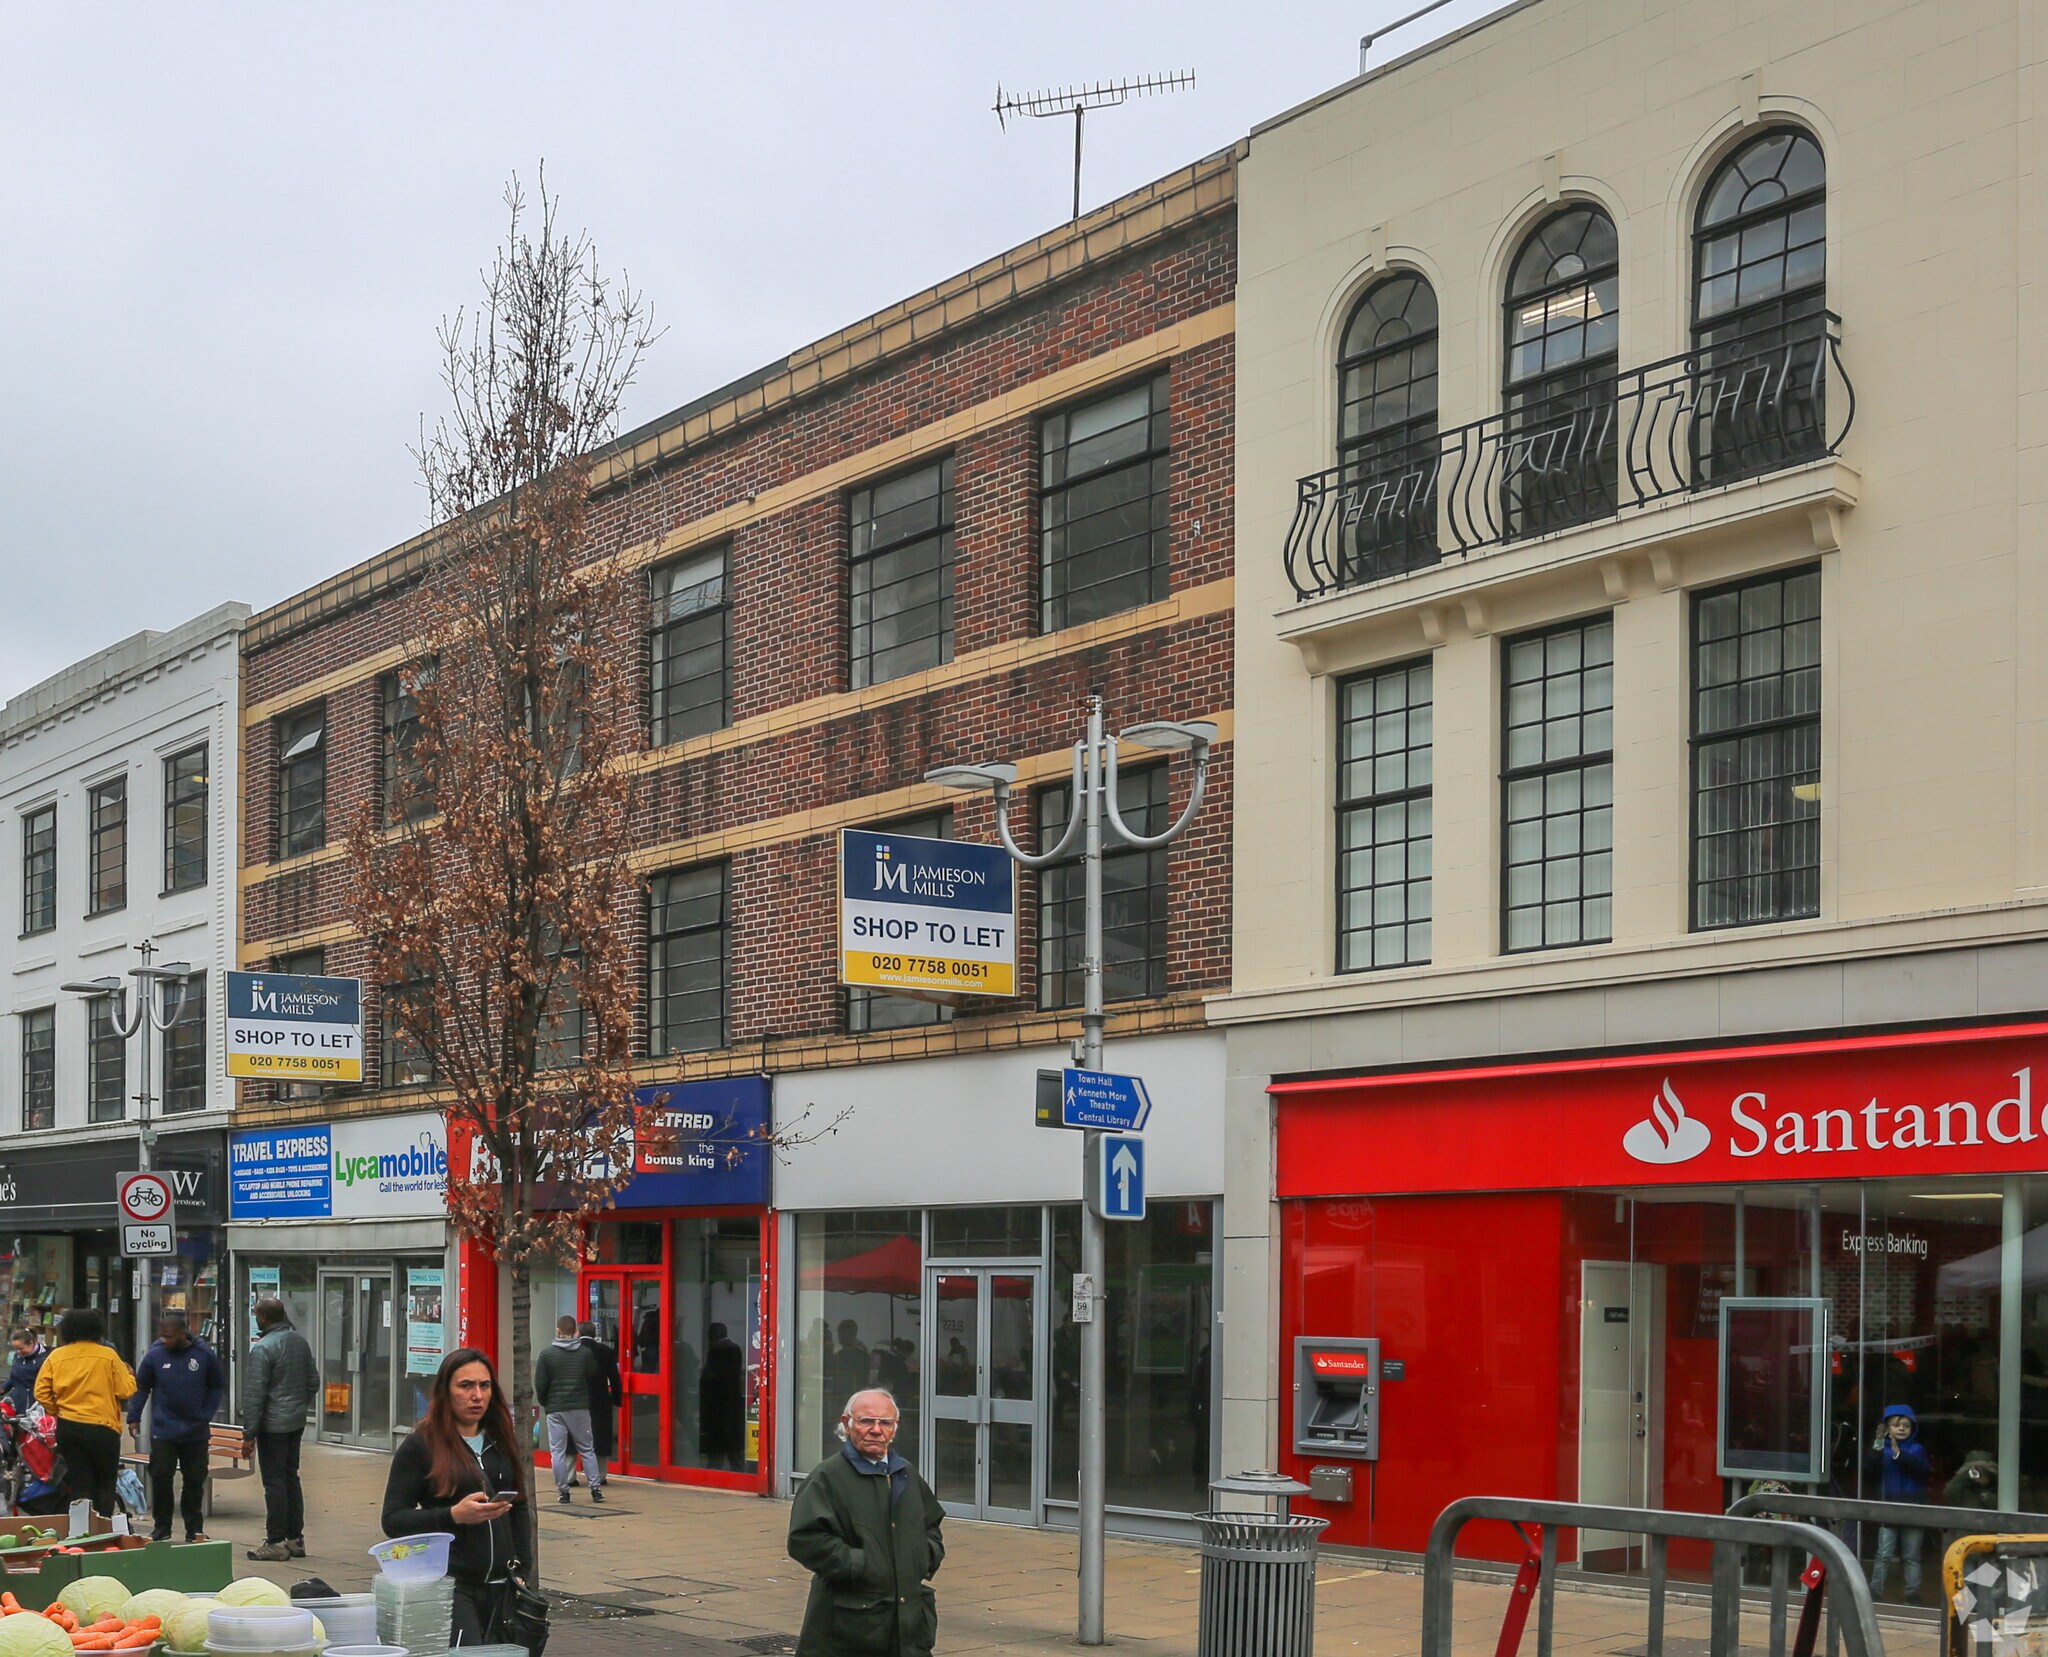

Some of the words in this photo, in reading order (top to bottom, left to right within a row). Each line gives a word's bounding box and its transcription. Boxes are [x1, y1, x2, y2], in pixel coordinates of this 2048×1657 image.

[912, 865, 985, 885] JAMIESON
[913, 882, 955, 898] MILLS
[853, 916, 918, 940] SHOP
[925, 922, 956, 943] TO
[963, 926, 1005, 948] LET
[872, 955, 901, 971] 020
[908, 958, 946, 974] 7758
[952, 962, 988, 977] 0051
[879, 973, 983, 988] www.jamiesonmills.com
[280, 993, 338, 1006] JAMIESON
[281, 1005, 314, 1015] MILLS
[235, 1029, 285, 1045] SHOP
[291, 1032, 315, 1047] TO
[321, 1034, 354, 1048] LET
[250, 1056, 272, 1066] 020
[278, 1057, 307, 1068] 7758
[312, 1059, 340, 1069] 0051
[255, 1067, 336, 1076] www.jamiesonmills.com
[1078, 1074, 1096, 1084] Town
[1097, 1076, 1113, 1086] Hall
[1078, 1088, 1107, 1099] Kenneth
[1109, 1091, 1127, 1102] More
[1089, 1100, 1115, 1111] Theatre
[1730, 1067, 2048, 1157] Santand
[651, 1112, 713, 1130] ETFRED
[1078, 1112, 1105, 1123] Central
[1107, 1115, 1130, 1127] Library
[232, 1141, 273, 1163] TRAVEL
[276, 1136, 328, 1159] EXPRESS
[698, 1143, 714, 1154] the
[335, 1143, 448, 1187] Lycamobile
[644, 1153, 683, 1165] bonus
[688, 1155, 715, 1169] king
[169, 1171, 203, 1196] W
[379, 1182, 392, 1193] Call
[392, 1181, 403, 1192] the
[405, 1181, 423, 1191] world
[424, 1180, 434, 1190] for
[173, 1199, 206, 1207] terstone's
[140, 1229, 156, 1238] No
[130, 1240, 167, 1250] cycling
[1887, 1233, 1928, 1260] Banking
[1327, 1359, 1365, 1370] Santander
